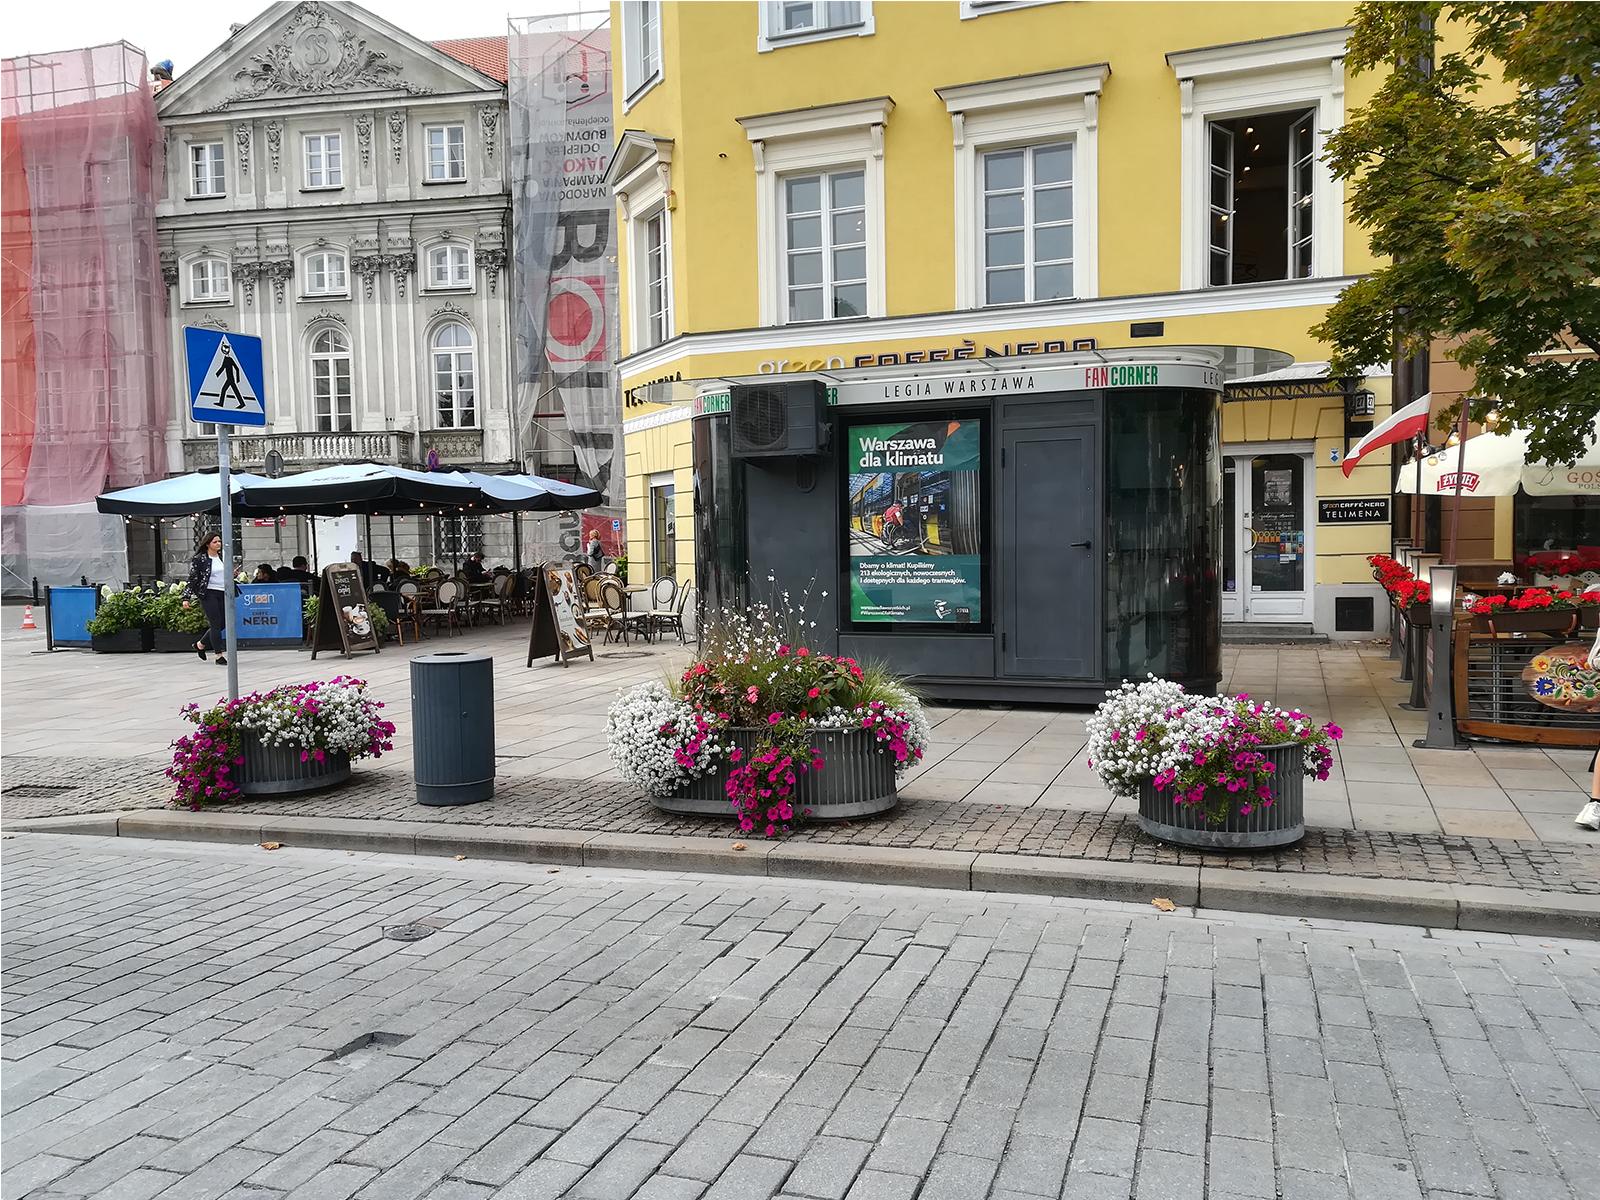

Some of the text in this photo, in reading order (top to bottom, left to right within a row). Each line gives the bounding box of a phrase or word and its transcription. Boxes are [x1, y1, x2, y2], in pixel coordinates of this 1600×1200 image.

[884, 376, 1035, 398] LEGIA WARSZAWA
[1356, 397, 1365, 407] 27
[859, 437, 936, 452] Warszawa
[859, 450, 944, 468] dla klimatu
[1325, 510, 1381, 518] TELIMENA
[859, 562, 880, 570] Dbamy
[871, 570, 912, 578] ekologicznych,
[863, 577, 896, 585] dostępnych
[906, 577, 931, 585] każdego
[243, 593, 275, 606] green
[243, 616, 278, 626] NERO
